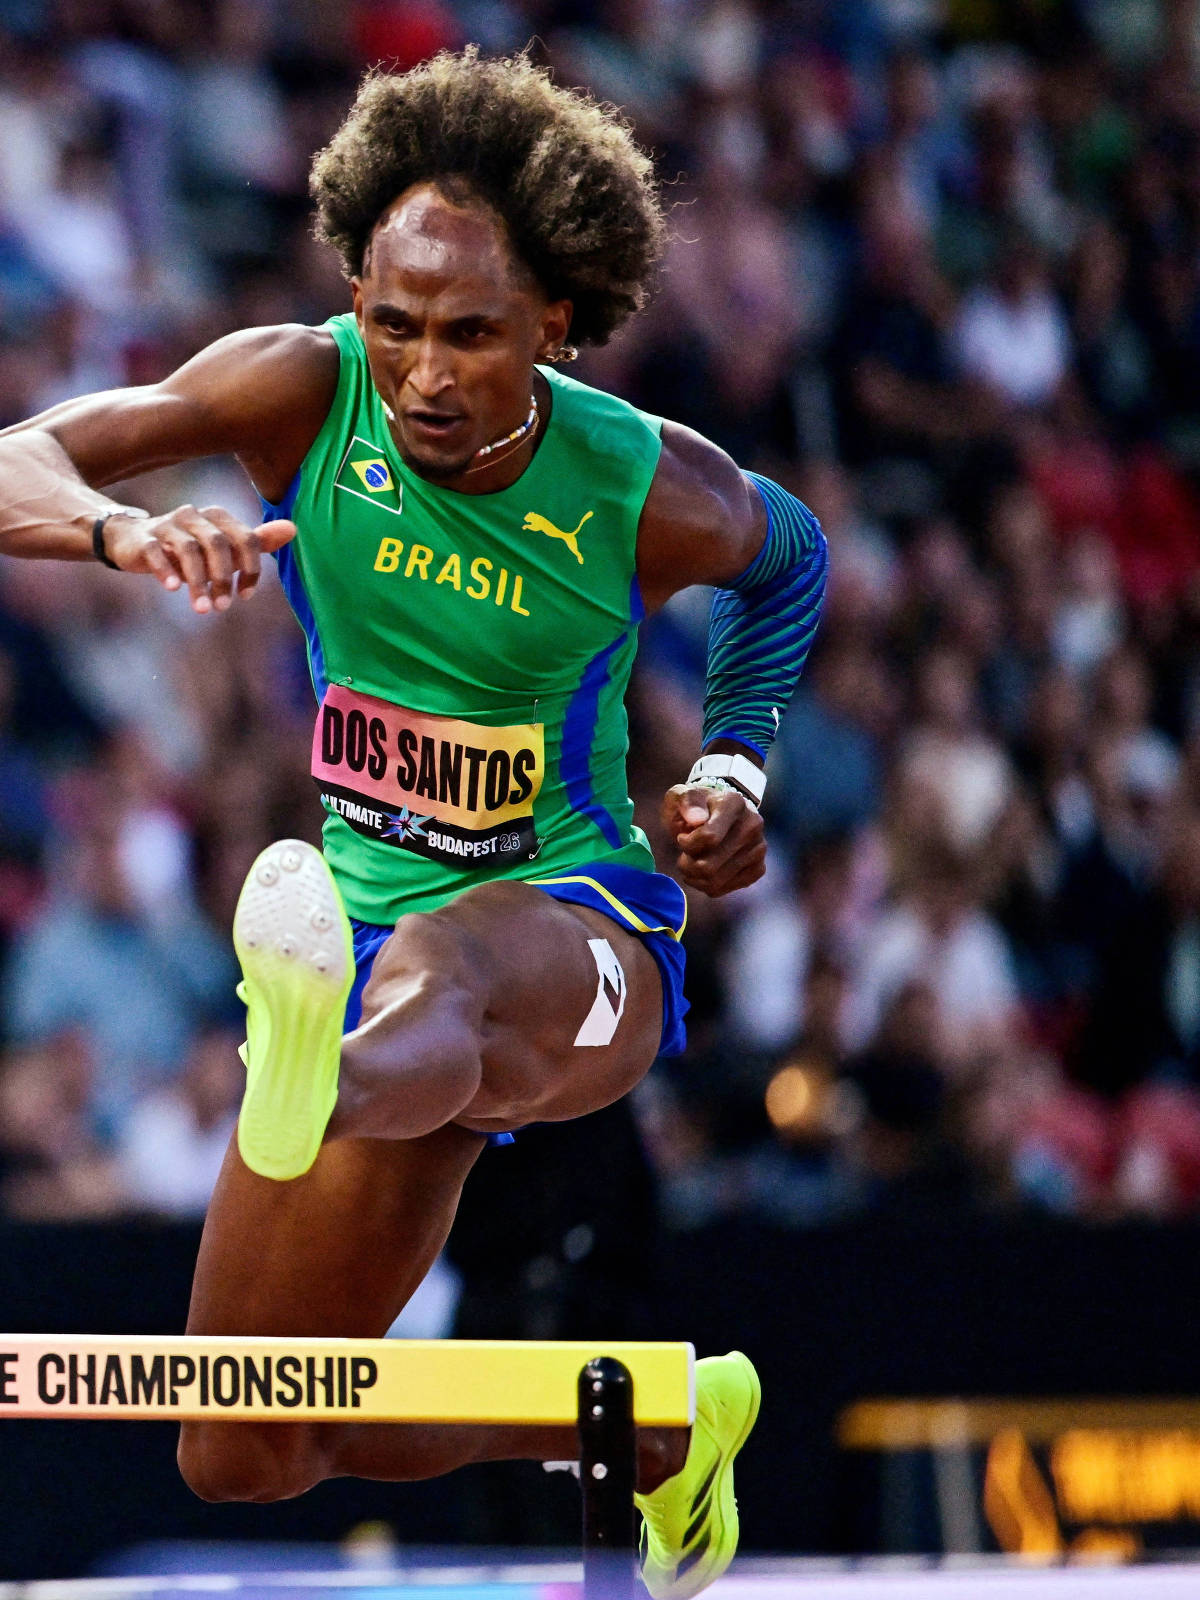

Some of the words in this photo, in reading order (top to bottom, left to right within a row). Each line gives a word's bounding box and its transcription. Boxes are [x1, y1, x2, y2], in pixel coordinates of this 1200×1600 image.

[373, 537, 531, 617] BRASIL
[321, 703, 388, 781] DOS
[396, 728, 536, 813] SANTOS
[427, 830, 498, 858] BUDAPEST
[500, 832, 521, 852] 26
[37, 1352, 378, 1408] CHAMPIONSHIP
